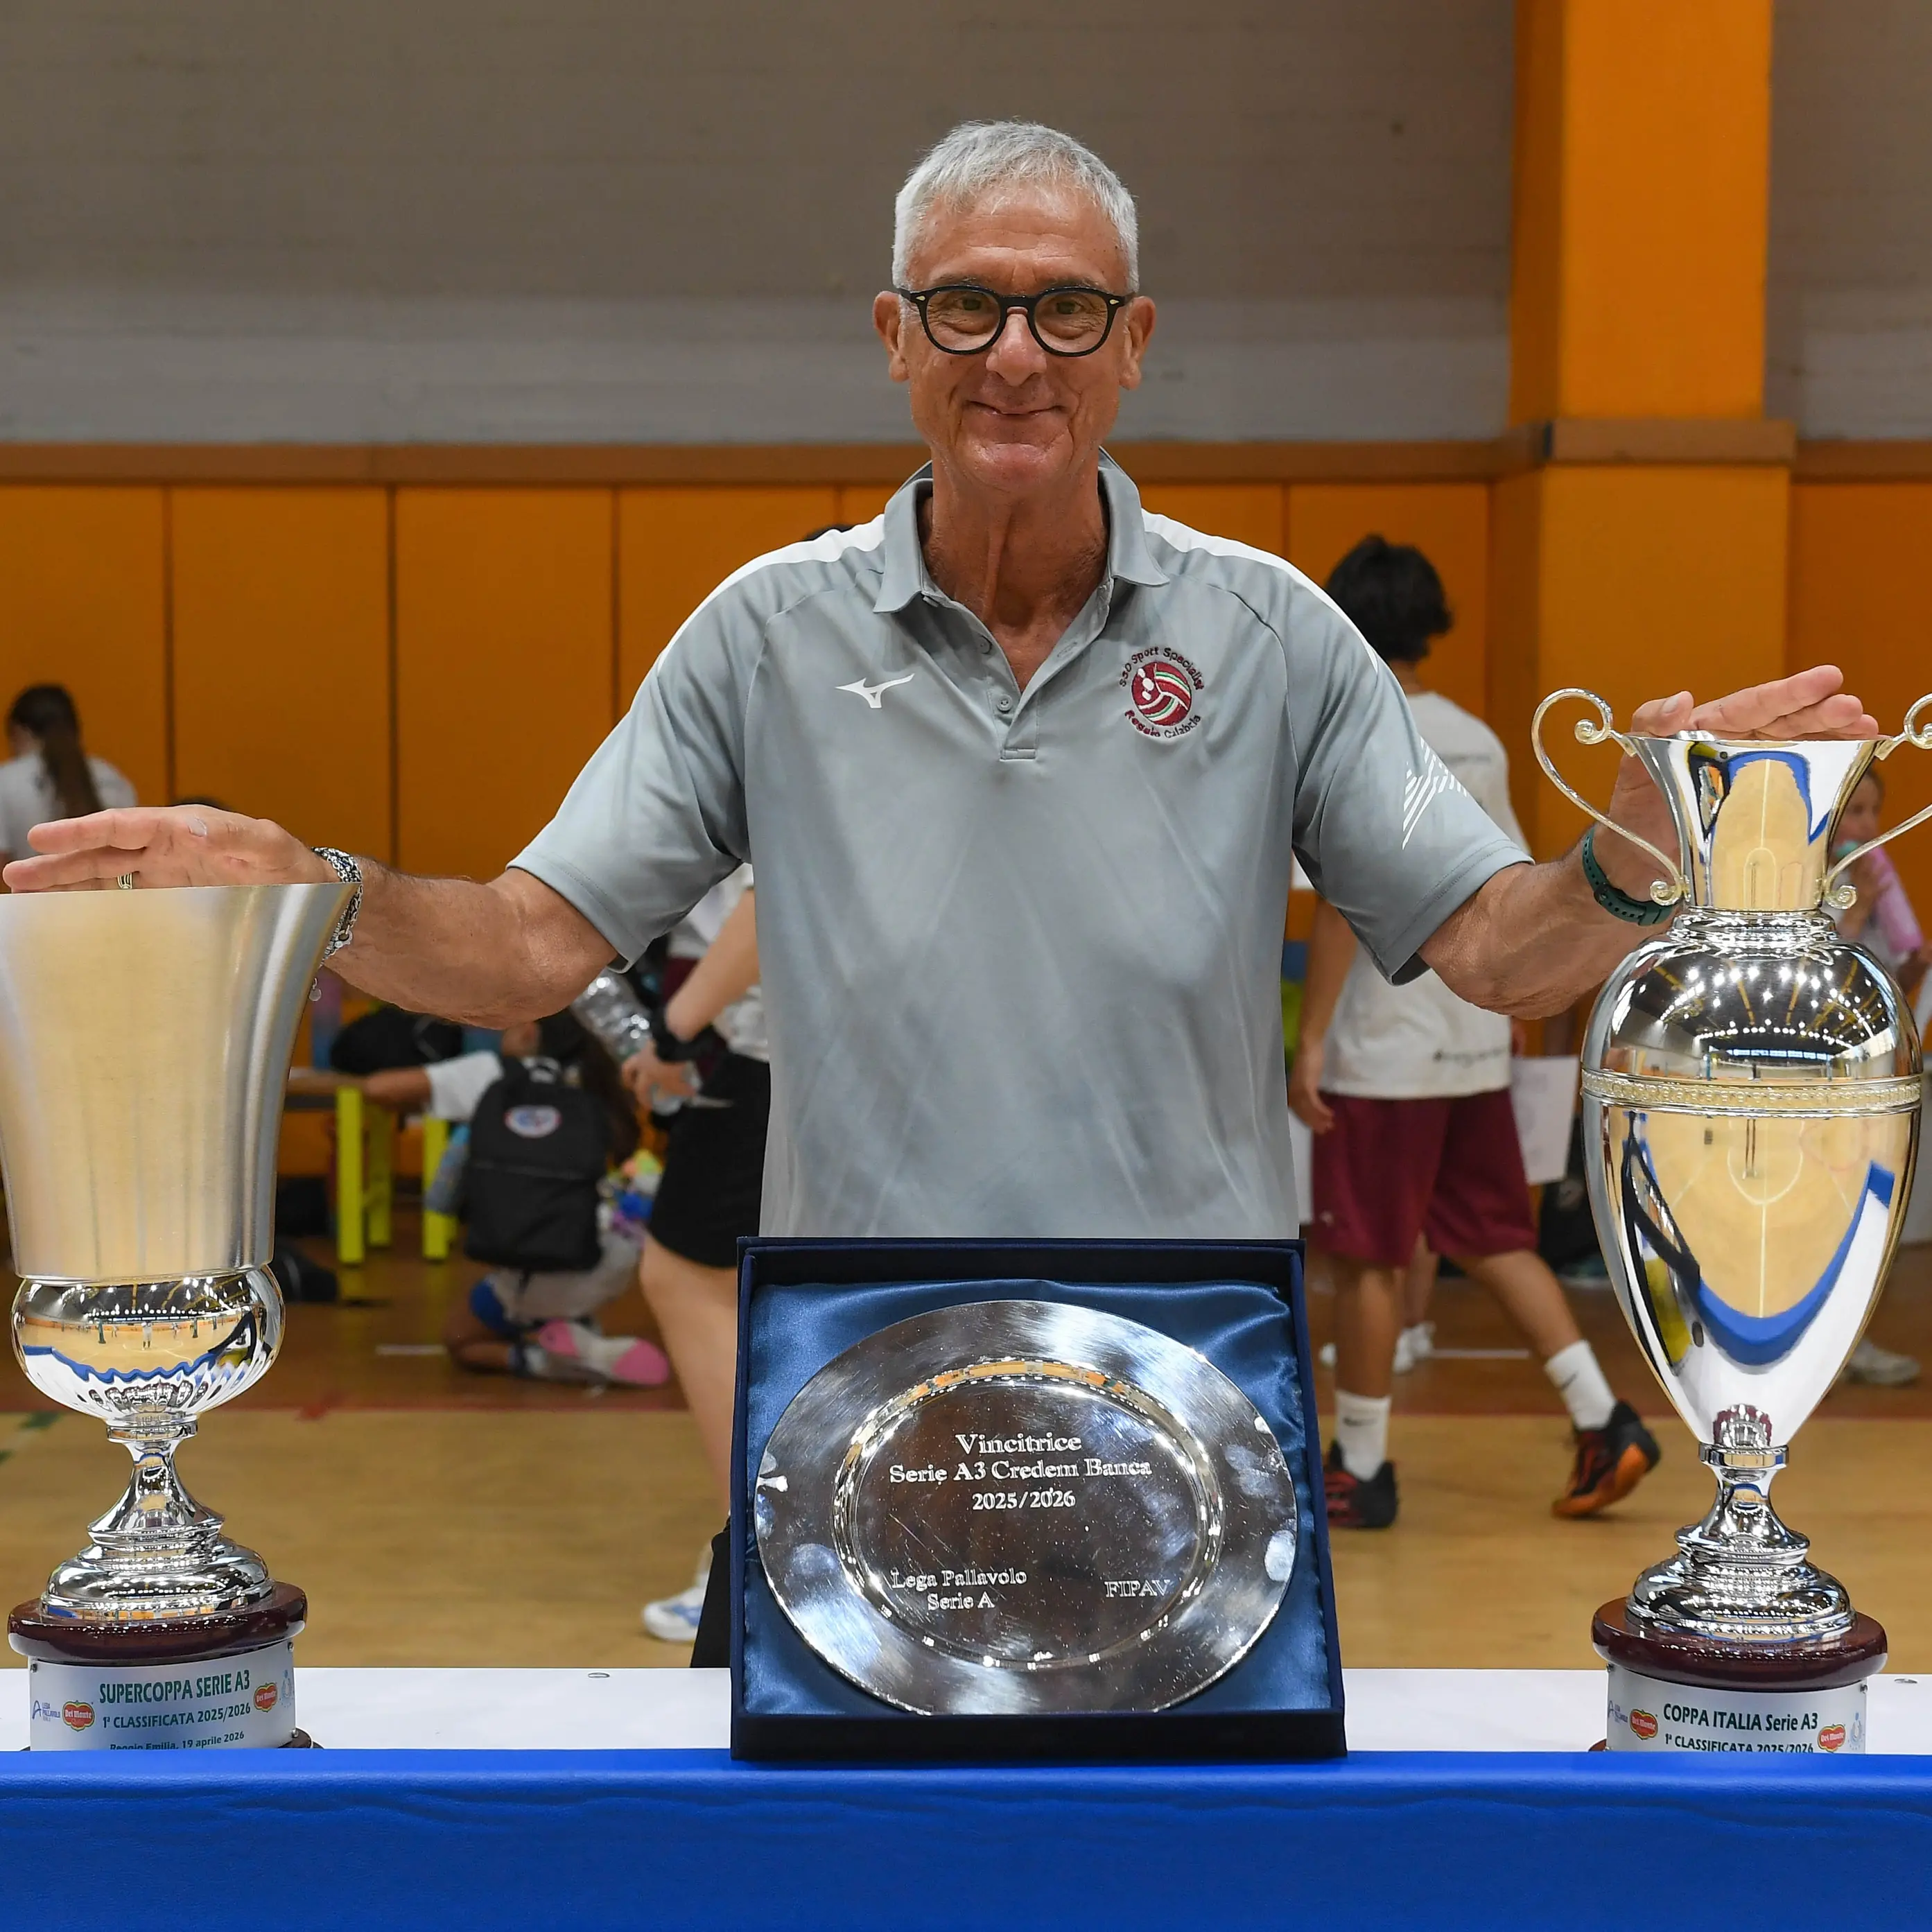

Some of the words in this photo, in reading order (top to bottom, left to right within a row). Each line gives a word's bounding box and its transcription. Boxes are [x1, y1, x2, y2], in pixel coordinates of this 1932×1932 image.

[1131, 647, 1159, 663] Sport
[1163, 647, 1205, 690] Specialist
[1124, 710, 1160, 737] Reggio
[1164, 715, 1201, 738] Calabria
[955, 1432, 1081, 1454] Vincitrice
[889, 1464, 948, 1483] Serie
[953, 1461, 986, 1481] A3
[991, 1459, 1079, 1480] Credem
[1084, 1458, 1152, 1477] Banca
[973, 1490, 1076, 1510] 2025/2026
[891, 1569, 937, 1592] Lega
[941, 1567, 1027, 1587] Pallavolo
[1104, 1579, 1171, 1598] FIPAV
[928, 1592, 973, 1610] Serie
[977, 1591, 995, 1609] A
[99, 1680, 193, 1704] SUPERCOPPA
[196, 1673, 232, 1698] SERIE
[235, 1669, 250, 1691] A3
[114, 1712, 195, 1728] CLASSIFICATA
[198, 1703, 251, 1723] 2025/2026
[1664, 1703, 1709, 1727] COPPA
[1713, 1711, 1762, 1731] ITALIA
[1766, 1714, 1798, 1731] Serie
[1800, 1712, 1818, 1730] A3
[182, 1739, 193, 1748] 19
[196, 1736, 222, 1748] aprile
[224, 1730, 245, 1743] 2026
[1675, 1735, 1753, 1752] CLASSIFICATA
